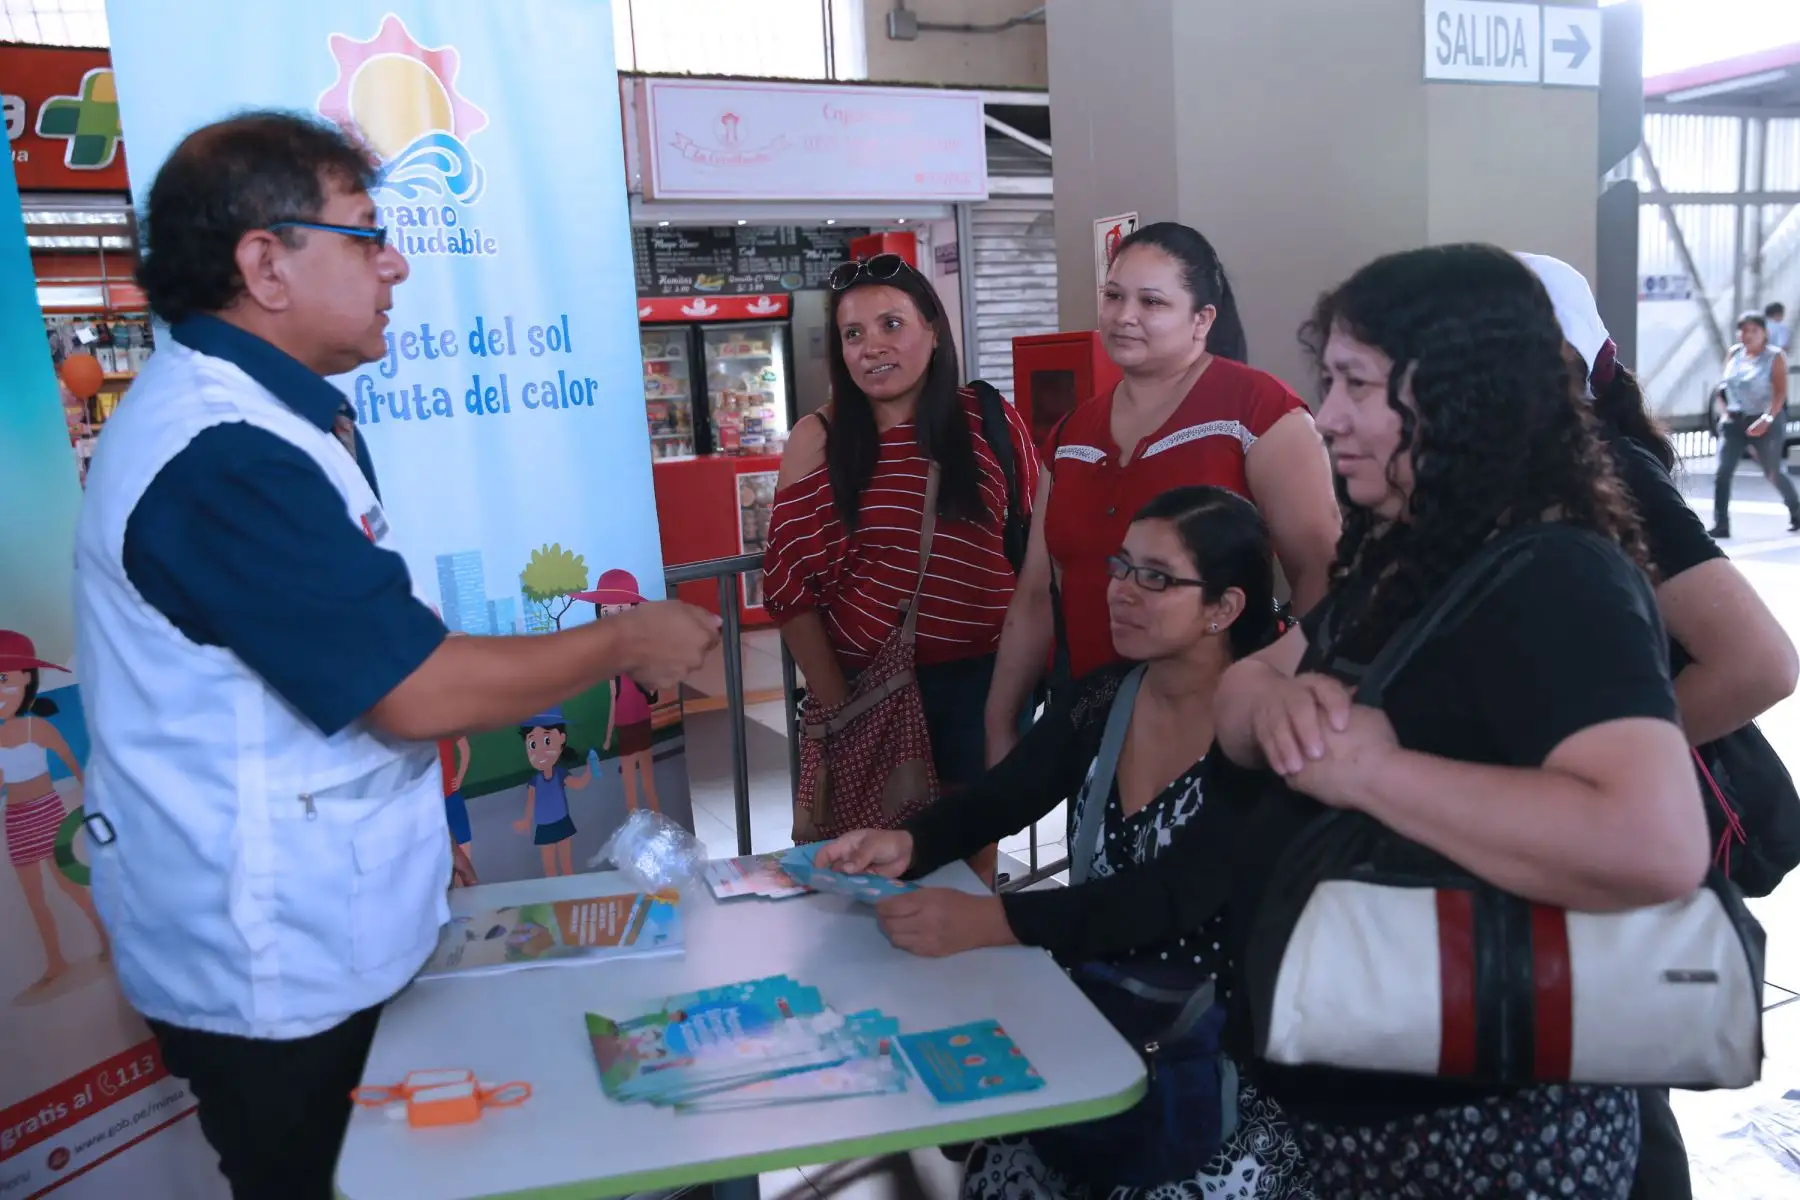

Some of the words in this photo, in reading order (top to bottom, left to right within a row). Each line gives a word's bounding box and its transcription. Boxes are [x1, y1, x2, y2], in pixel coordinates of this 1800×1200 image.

[1435, 10, 1528, 68] SALIDA
[385, 227, 497, 255] ludable
[468, 316, 517, 357] del
[528, 314, 573, 357] sol
[354, 374, 455, 425] fruta
[465, 373, 512, 416] del
[521, 369, 599, 410] calor
[0, 1100, 69, 1150] gratis
[72, 1083, 93, 1110] al
[116, 1054, 156, 1088] 113
